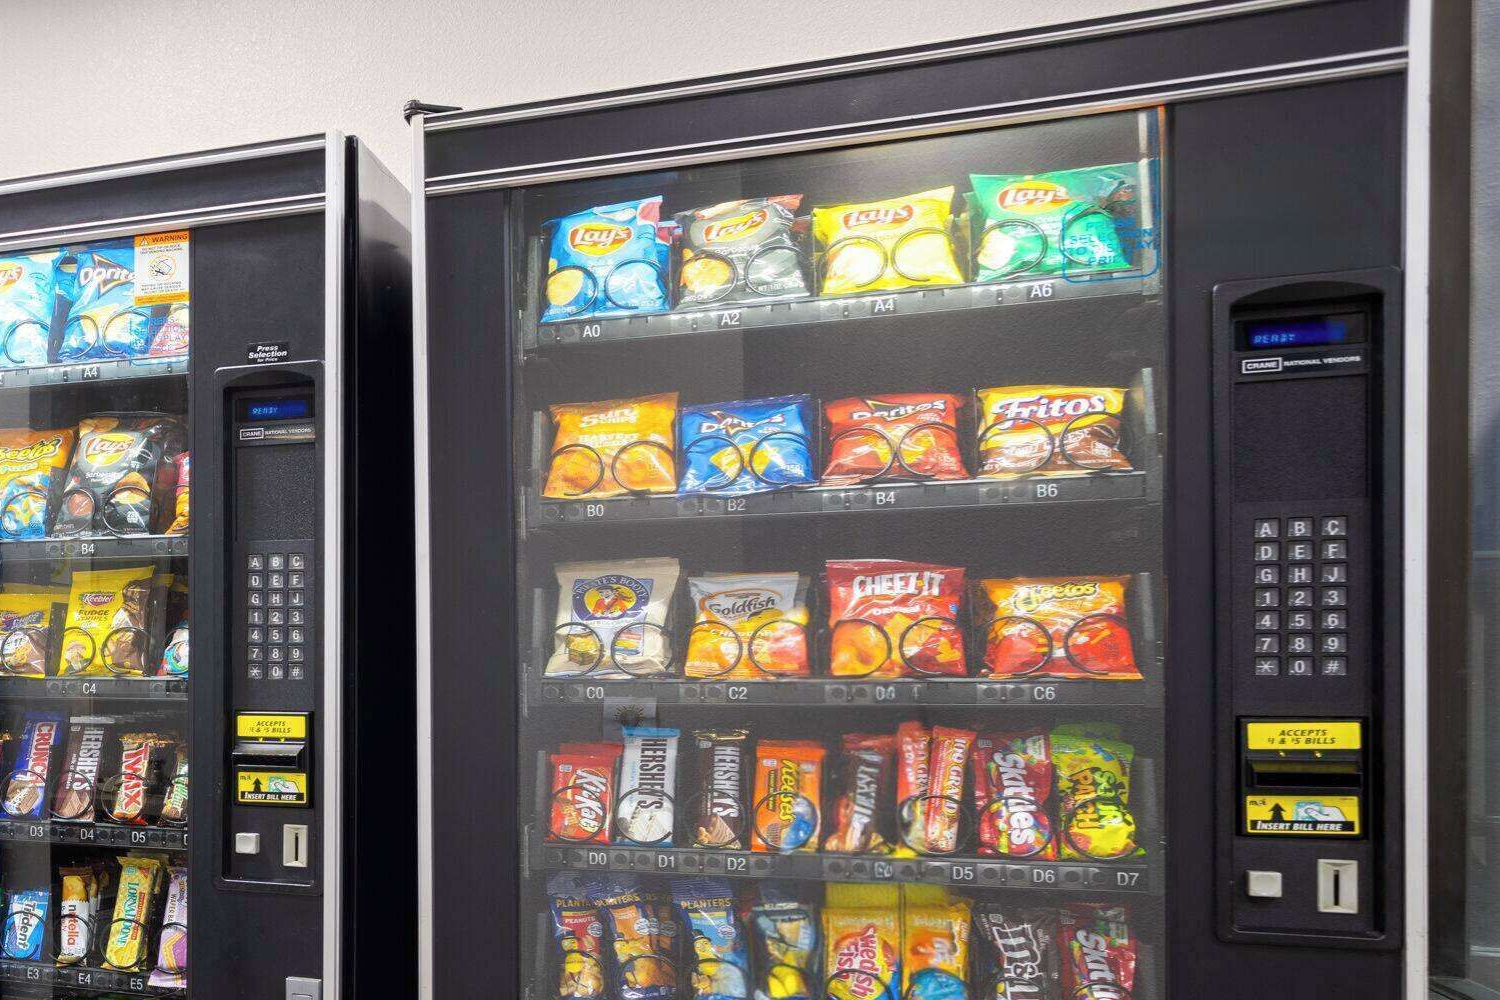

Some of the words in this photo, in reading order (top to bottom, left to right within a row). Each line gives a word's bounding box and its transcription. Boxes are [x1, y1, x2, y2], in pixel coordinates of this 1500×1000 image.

[1001, 188, 1070, 209] Lay's
[845, 206, 913, 228] Lay's
[151, 233, 188, 243] WARNING
[574, 226, 631, 247] Lay's
[1030, 284, 1053, 298] A6
[874, 298, 895, 313] A4
[720, 312, 741, 326] A2
[582, 325, 601, 338] A0
[248, 350, 288, 359] Selection
[1246, 361, 1278, 370] CRANE
[1283, 358, 1322, 366] NATIONAL
[1323, 355, 1362, 364] VENDORS
[83, 367, 98, 378] A4
[991, 395, 1106, 430] Fritos
[875, 491, 896, 505] B4
[1036, 484, 1058, 498] B6
[587, 504, 604, 517] B0
[727, 498, 746, 511] B2
[1260, 523, 1272, 535] A
[1294, 521, 1306, 534] B
[1327, 520, 1339, 533] C
[81, 544, 95, 555] B4
[1261, 546, 1272, 559] D
[1295, 545, 1305, 558] E
[1328, 544, 1339, 557] F
[1261, 569, 1272, 581] G
[1294, 568, 1305, 581] H
[1328, 567, 1338, 580] J
[1263, 592, 1271, 604] 1
[1294, 591, 1305, 604] 2
[1328, 591, 1338, 603] 3
[708, 596, 776, 616] Goldfish
[1261, 615, 1271, 626] 4
[1295, 614, 1305, 626] 5
[1327, 614, 1339, 627] 6
[1261, 638, 1271, 650] 7
[1294, 637, 1305, 650] 8
[1327, 637, 1339, 649] 9
[1294, 661, 1305, 673] 0
[82, 683, 97, 694] C4
[586, 686, 604, 699] C0
[728, 686, 748, 700] C2
[1033, 686, 1056, 700] C6
[122, 742, 150, 810] TWIX
[636, 738, 668, 810] HERSHEY'S
[712, 745, 741, 818] HERSHEY'S
[244, 791, 267, 800] INSERT
[30, 826, 44, 837] D3
[1256, 821, 1290, 831] INSERT
[1292, 822, 1314, 831] BILL
[1316, 823, 1343, 831] HERE
[80, 828, 94, 840] D4
[131, 831, 146, 843] D5
[589, 852, 607, 866] D0
[658, 855, 675, 868] D1
[727, 857, 746, 871] D2
[952, 866, 974, 880] D5
[1033, 869, 1055, 883] D6
[1116, 872, 1140, 886] D7
[680, 898, 732, 910] PLANTERS
[16, 896, 37, 950] Trident
[66, 904, 79, 947] nutella
[565, 916, 596, 924] PEANUTS
[27, 968, 40, 980] E3
[78, 973, 91, 985] E4
[130, 978, 143, 990] E5
